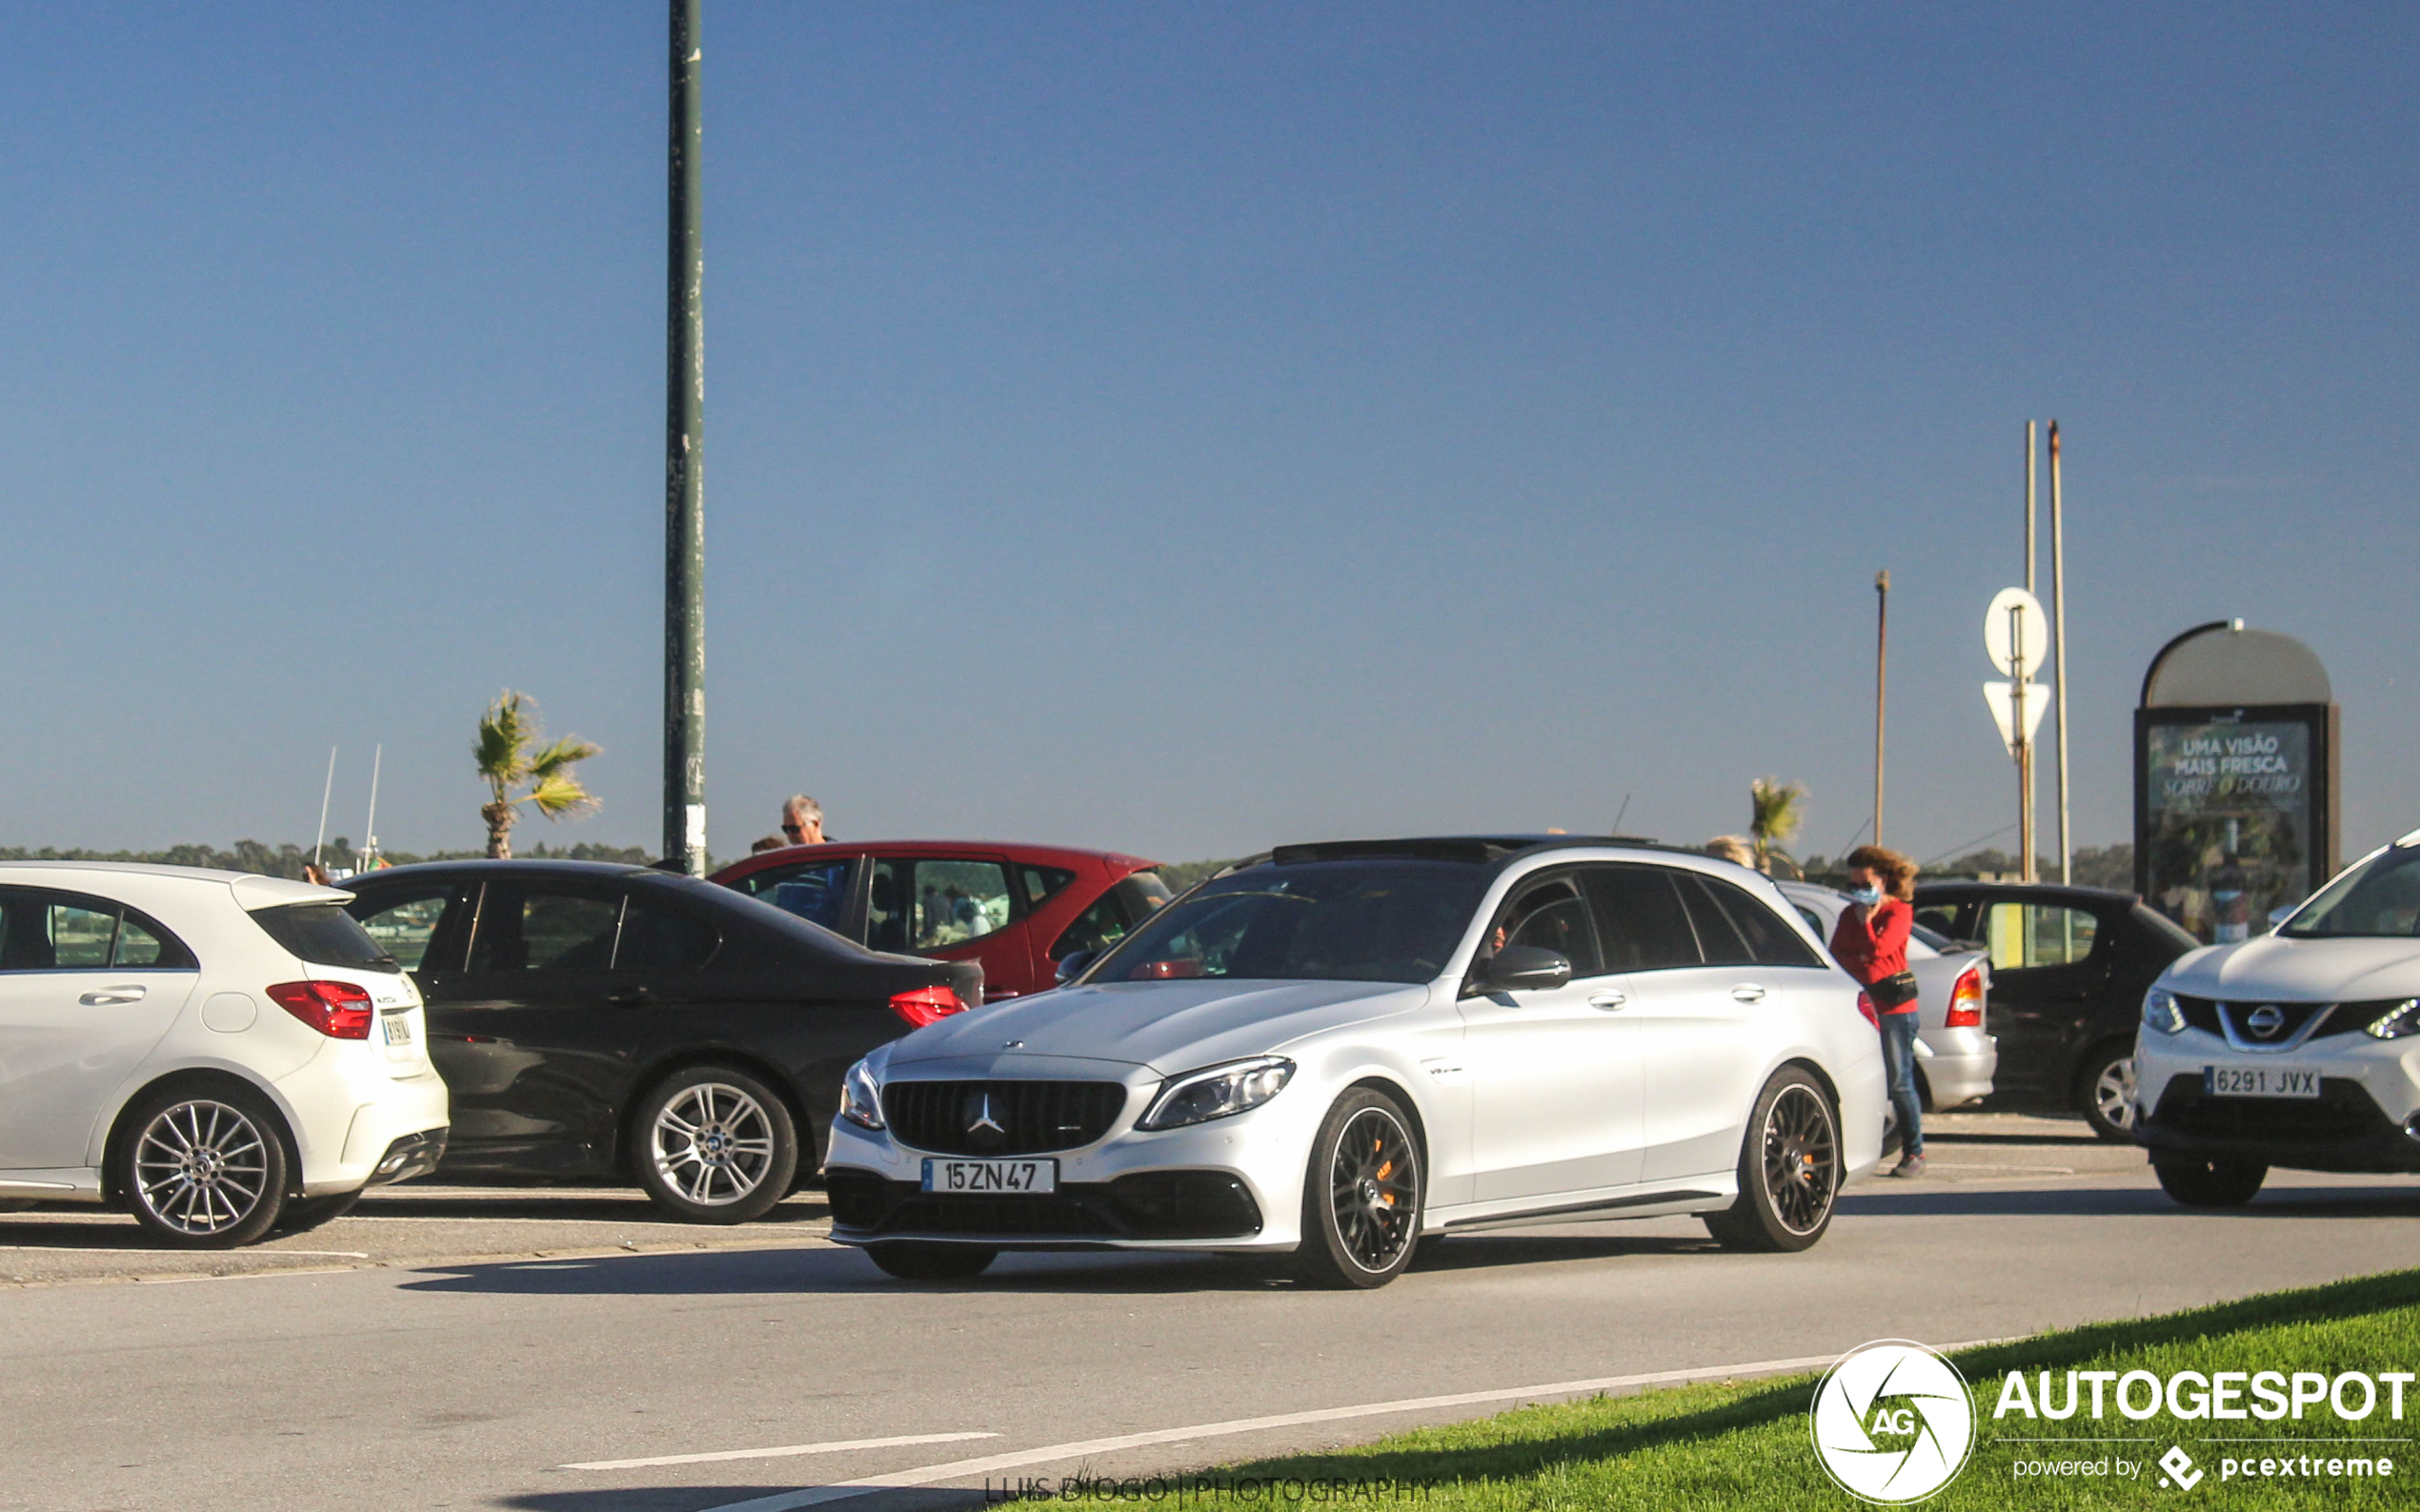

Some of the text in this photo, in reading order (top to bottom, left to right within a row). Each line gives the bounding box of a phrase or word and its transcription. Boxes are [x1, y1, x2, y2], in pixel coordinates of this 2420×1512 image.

[2182, 732, 2280, 756] UMA VISÃO
[2174, 756, 2288, 776] MAIS FRESCA
[2236, 775, 2302, 795] DOURO
[2217, 1070, 2314, 1094] 6291 JVX
